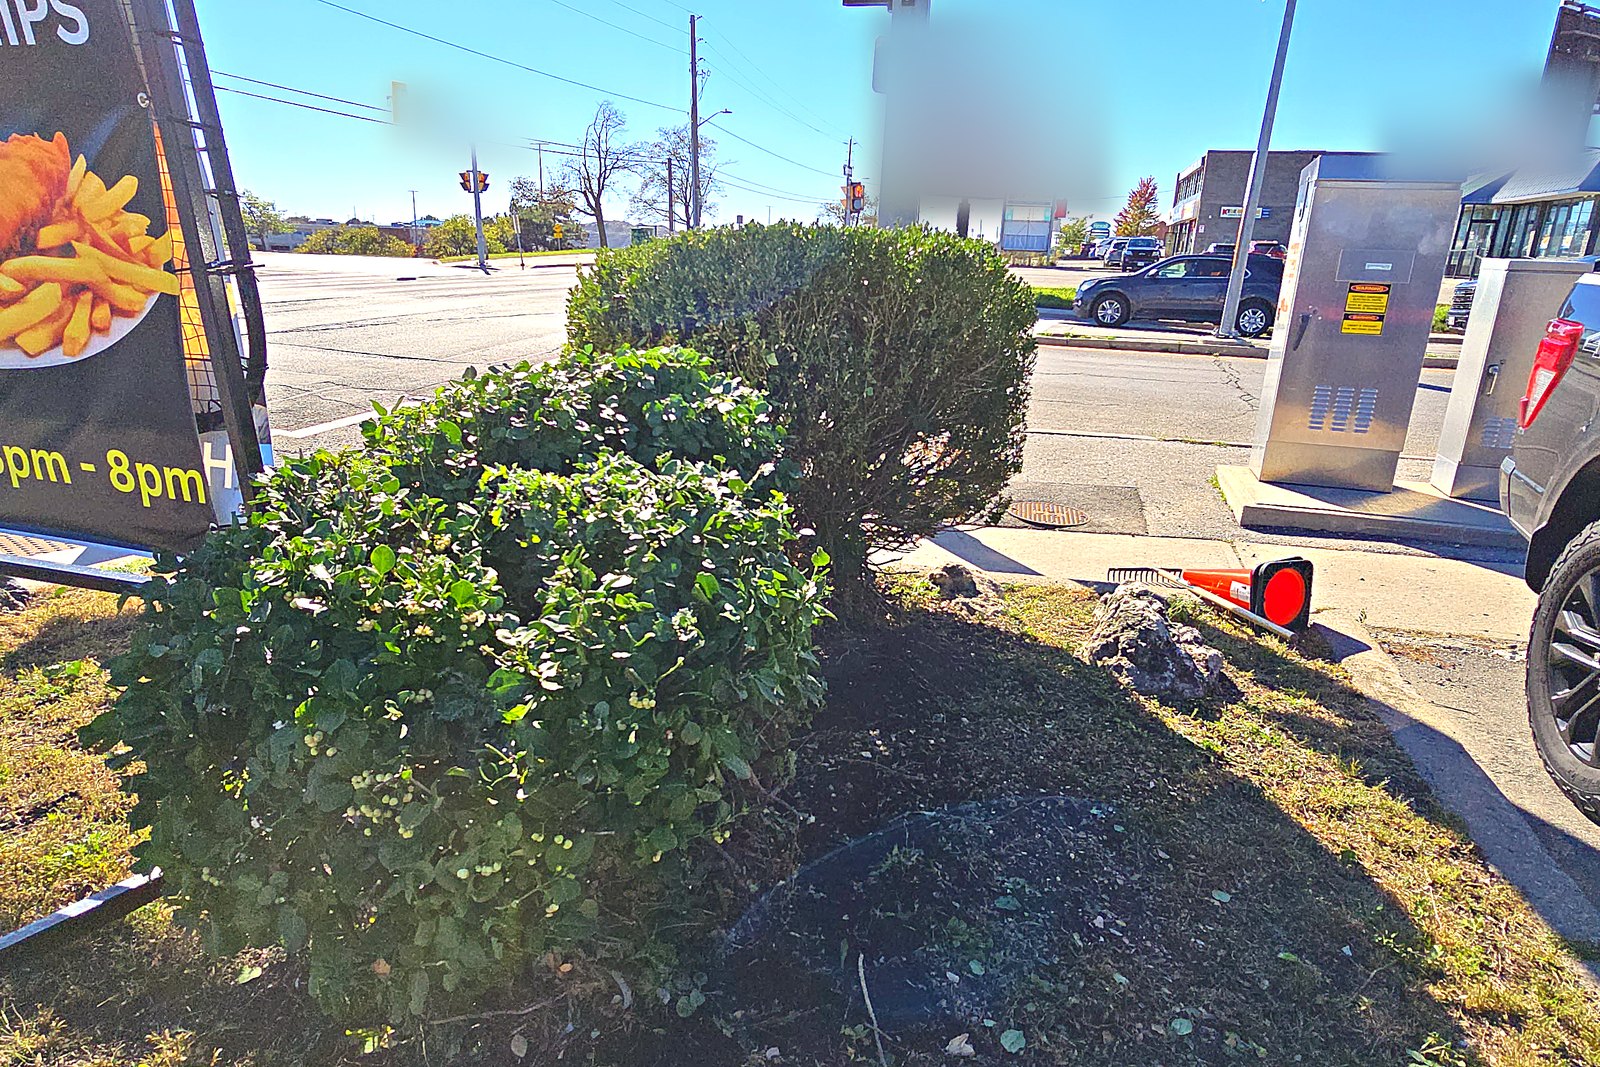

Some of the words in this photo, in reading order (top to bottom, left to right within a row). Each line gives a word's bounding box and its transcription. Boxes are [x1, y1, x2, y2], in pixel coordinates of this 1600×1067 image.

[0, 0, 90, 45] IPS
[0, 445, 72, 488] pm
[106, 449, 207, 508] 8pm
